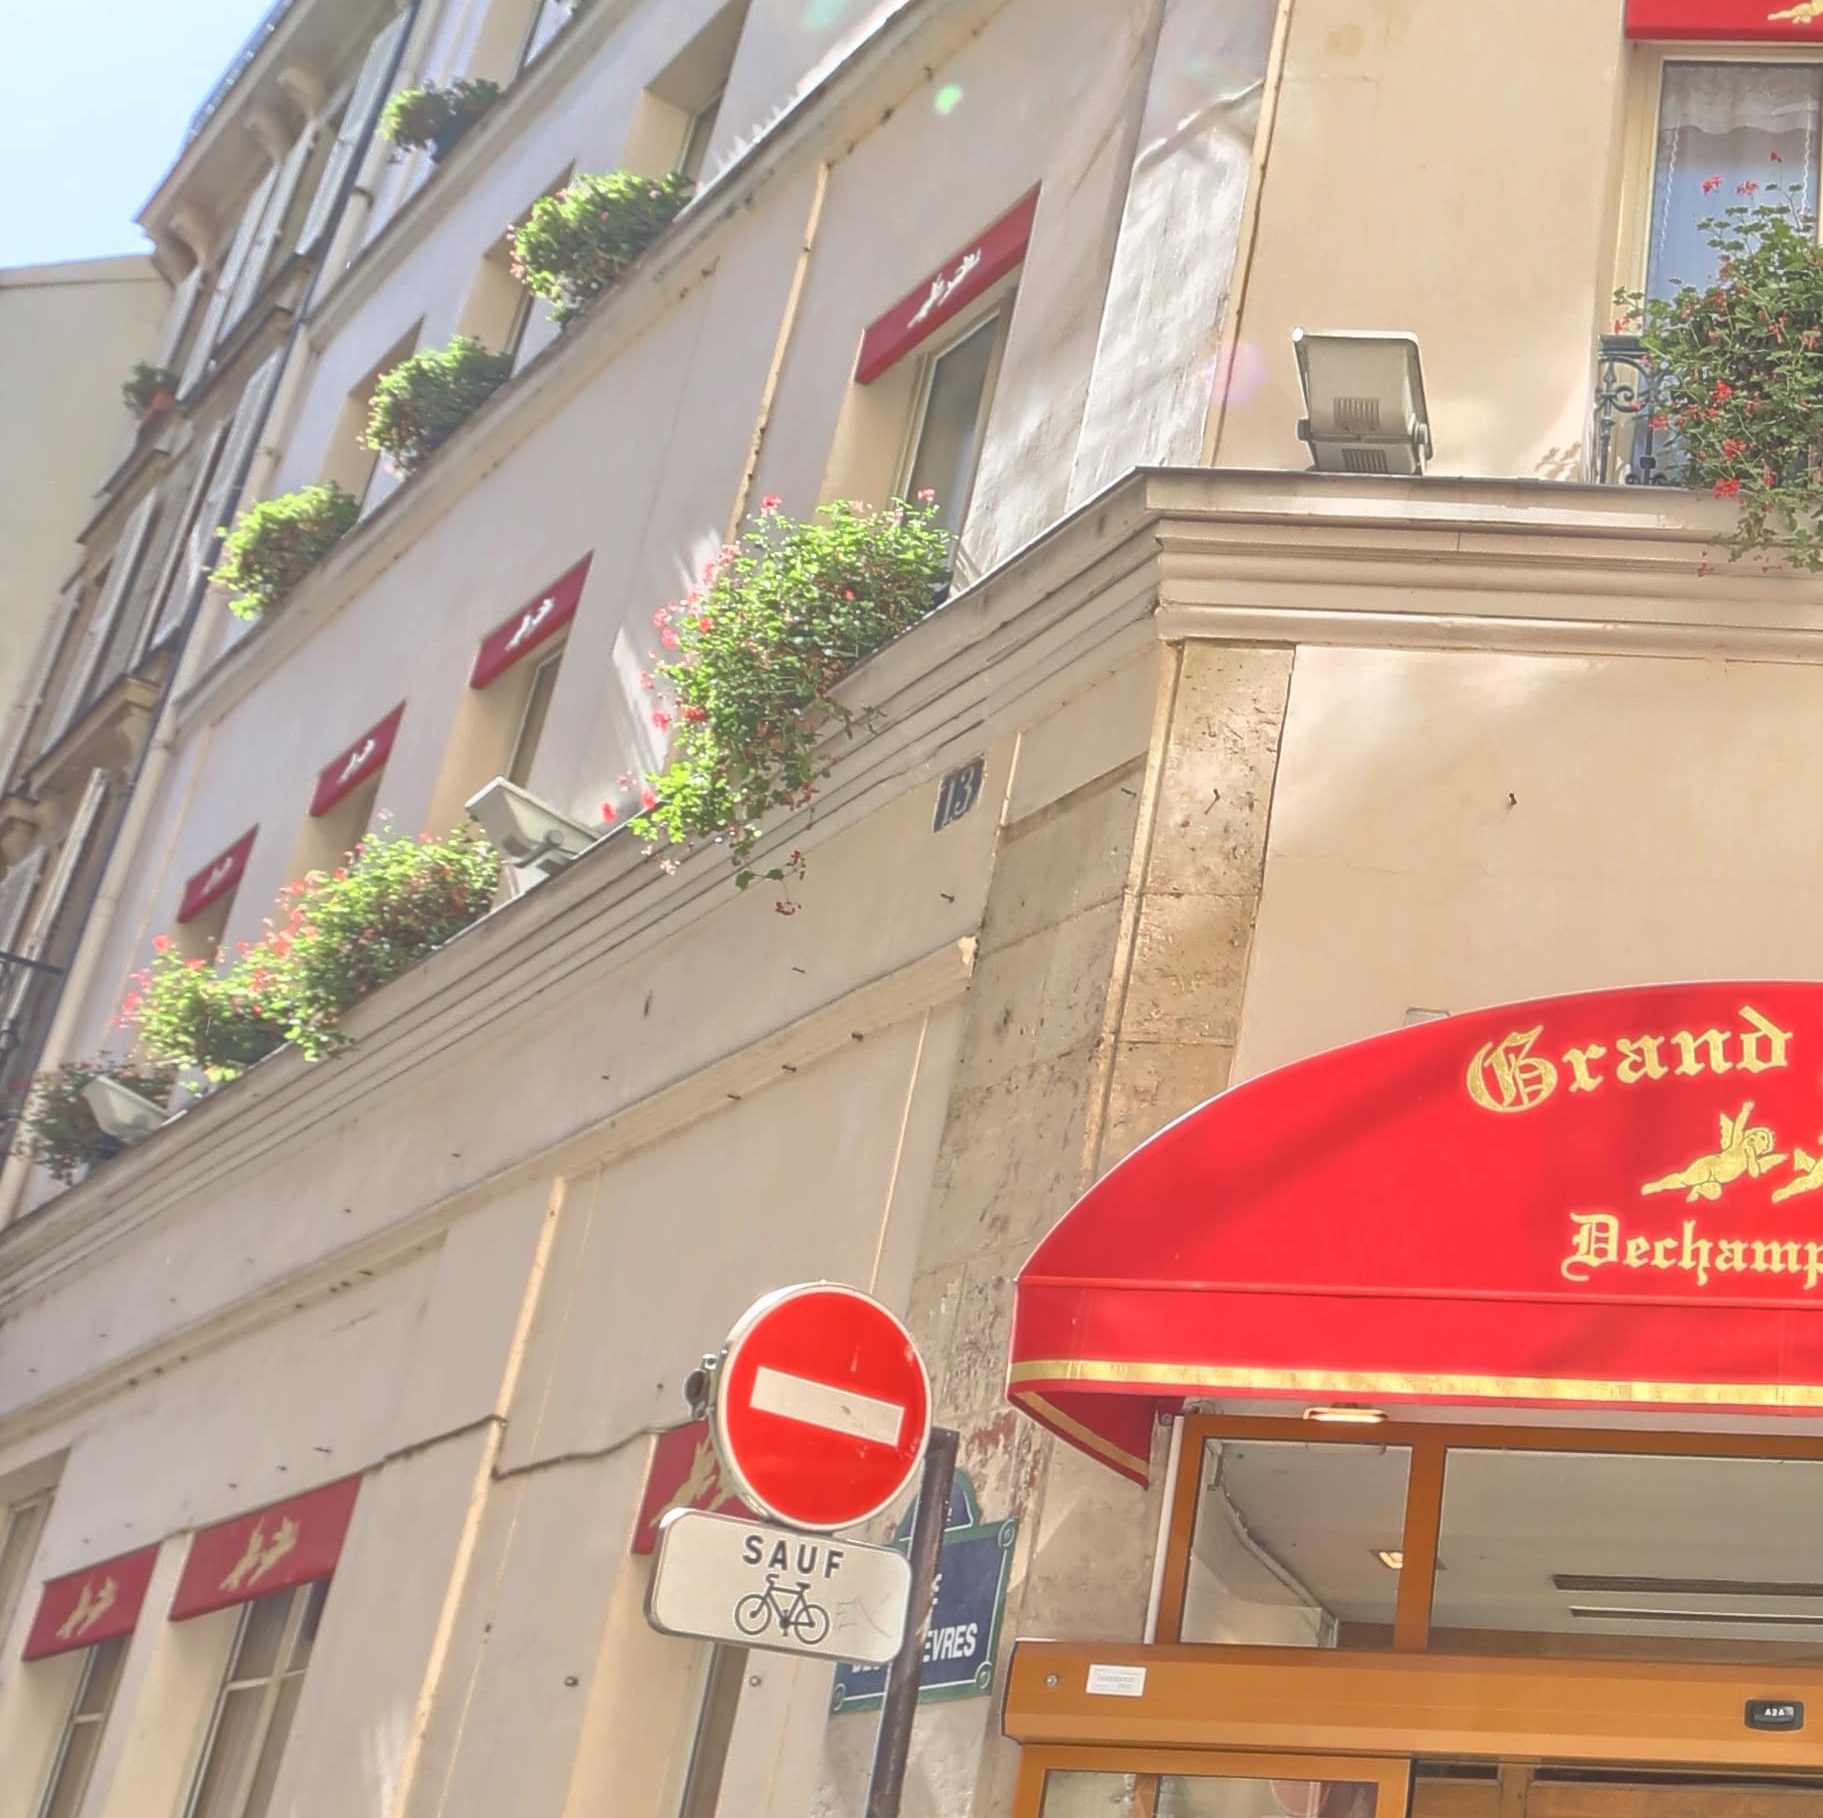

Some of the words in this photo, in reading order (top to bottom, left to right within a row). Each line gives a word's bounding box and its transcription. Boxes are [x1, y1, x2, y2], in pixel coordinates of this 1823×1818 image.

[942, 766, 975, 827] 13
[1466, 1005, 1793, 1113] Grand
[742, 1534, 845, 1580] SAUF
